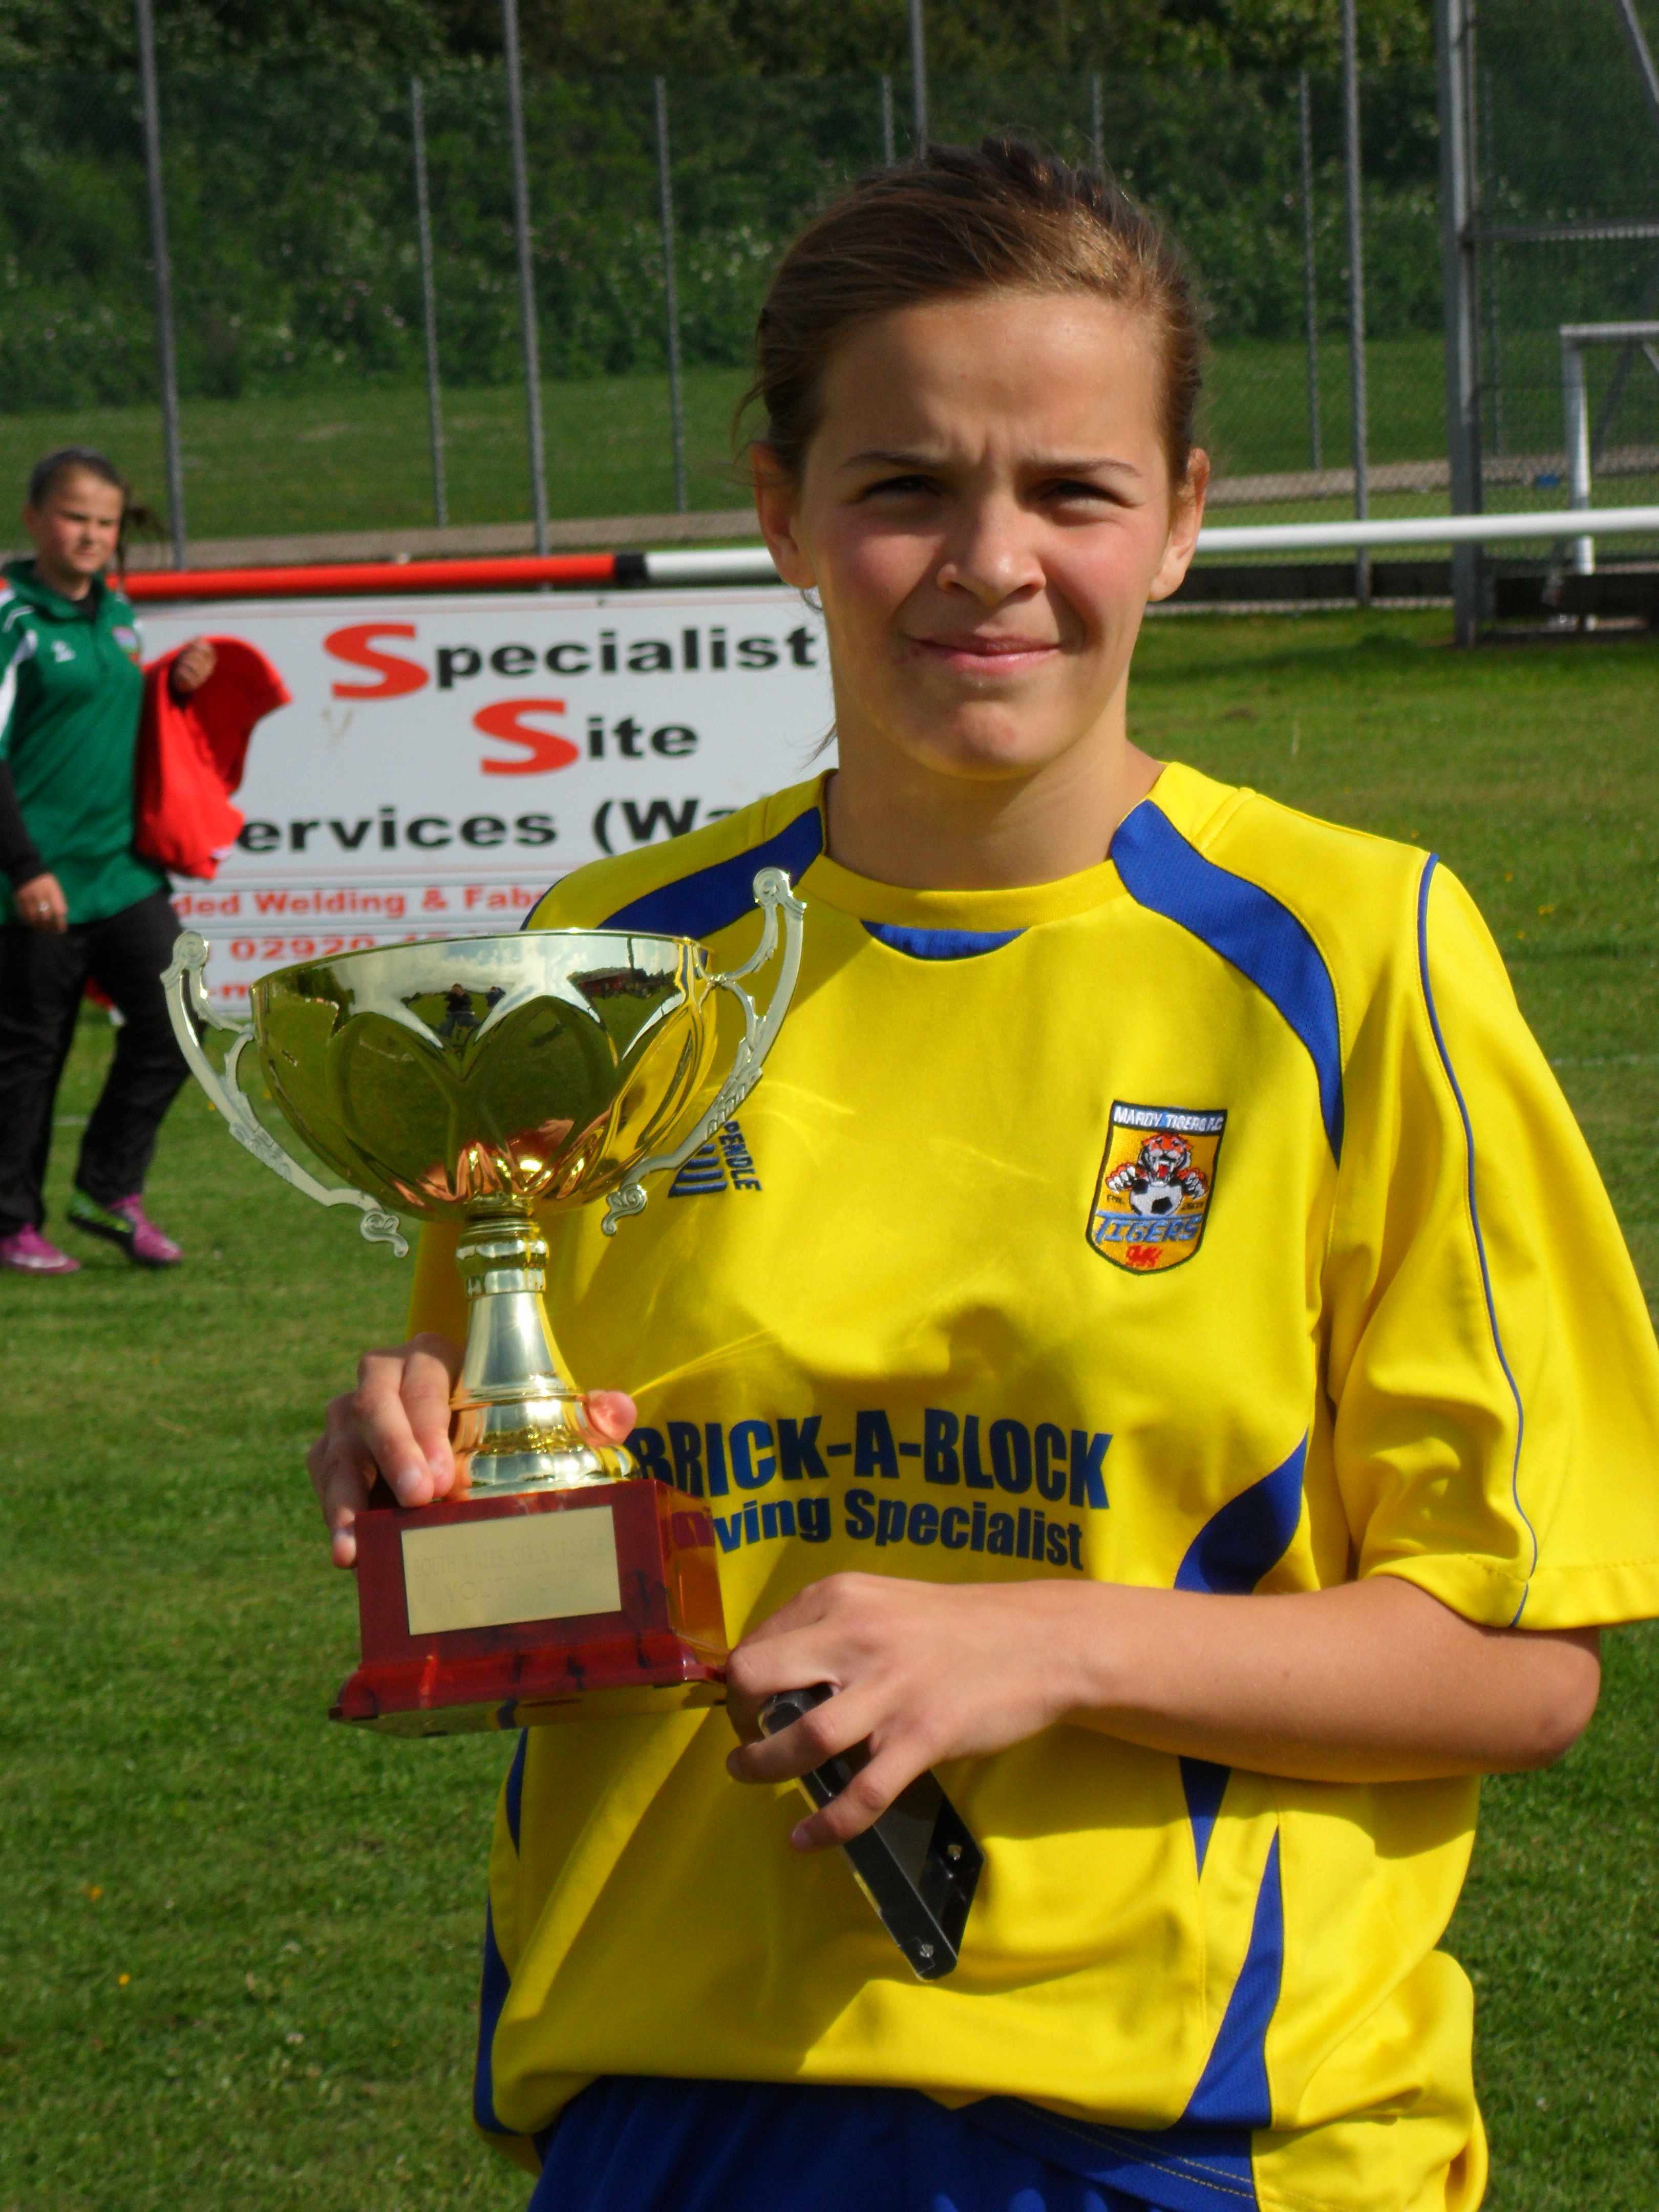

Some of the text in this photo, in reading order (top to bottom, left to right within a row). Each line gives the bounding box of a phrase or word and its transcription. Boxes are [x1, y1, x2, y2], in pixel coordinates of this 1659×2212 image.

[323, 623, 817, 700] Specialist
[472, 699, 699, 777] Site
[236, 806, 558, 853] ervices
[171, 892, 239, 918] ded
[254, 888, 406, 919] Welding
[421, 885, 449, 911] &
[1114, 1105, 1162, 1127] MARDY
[718, 1120, 762, 1191] PENDLE
[1095, 1210, 1203, 1245] TIGERS
[622, 1408, 1114, 1511] BRICK-A-BLOCK
[712, 1487, 1084, 1572] ving Specialist
